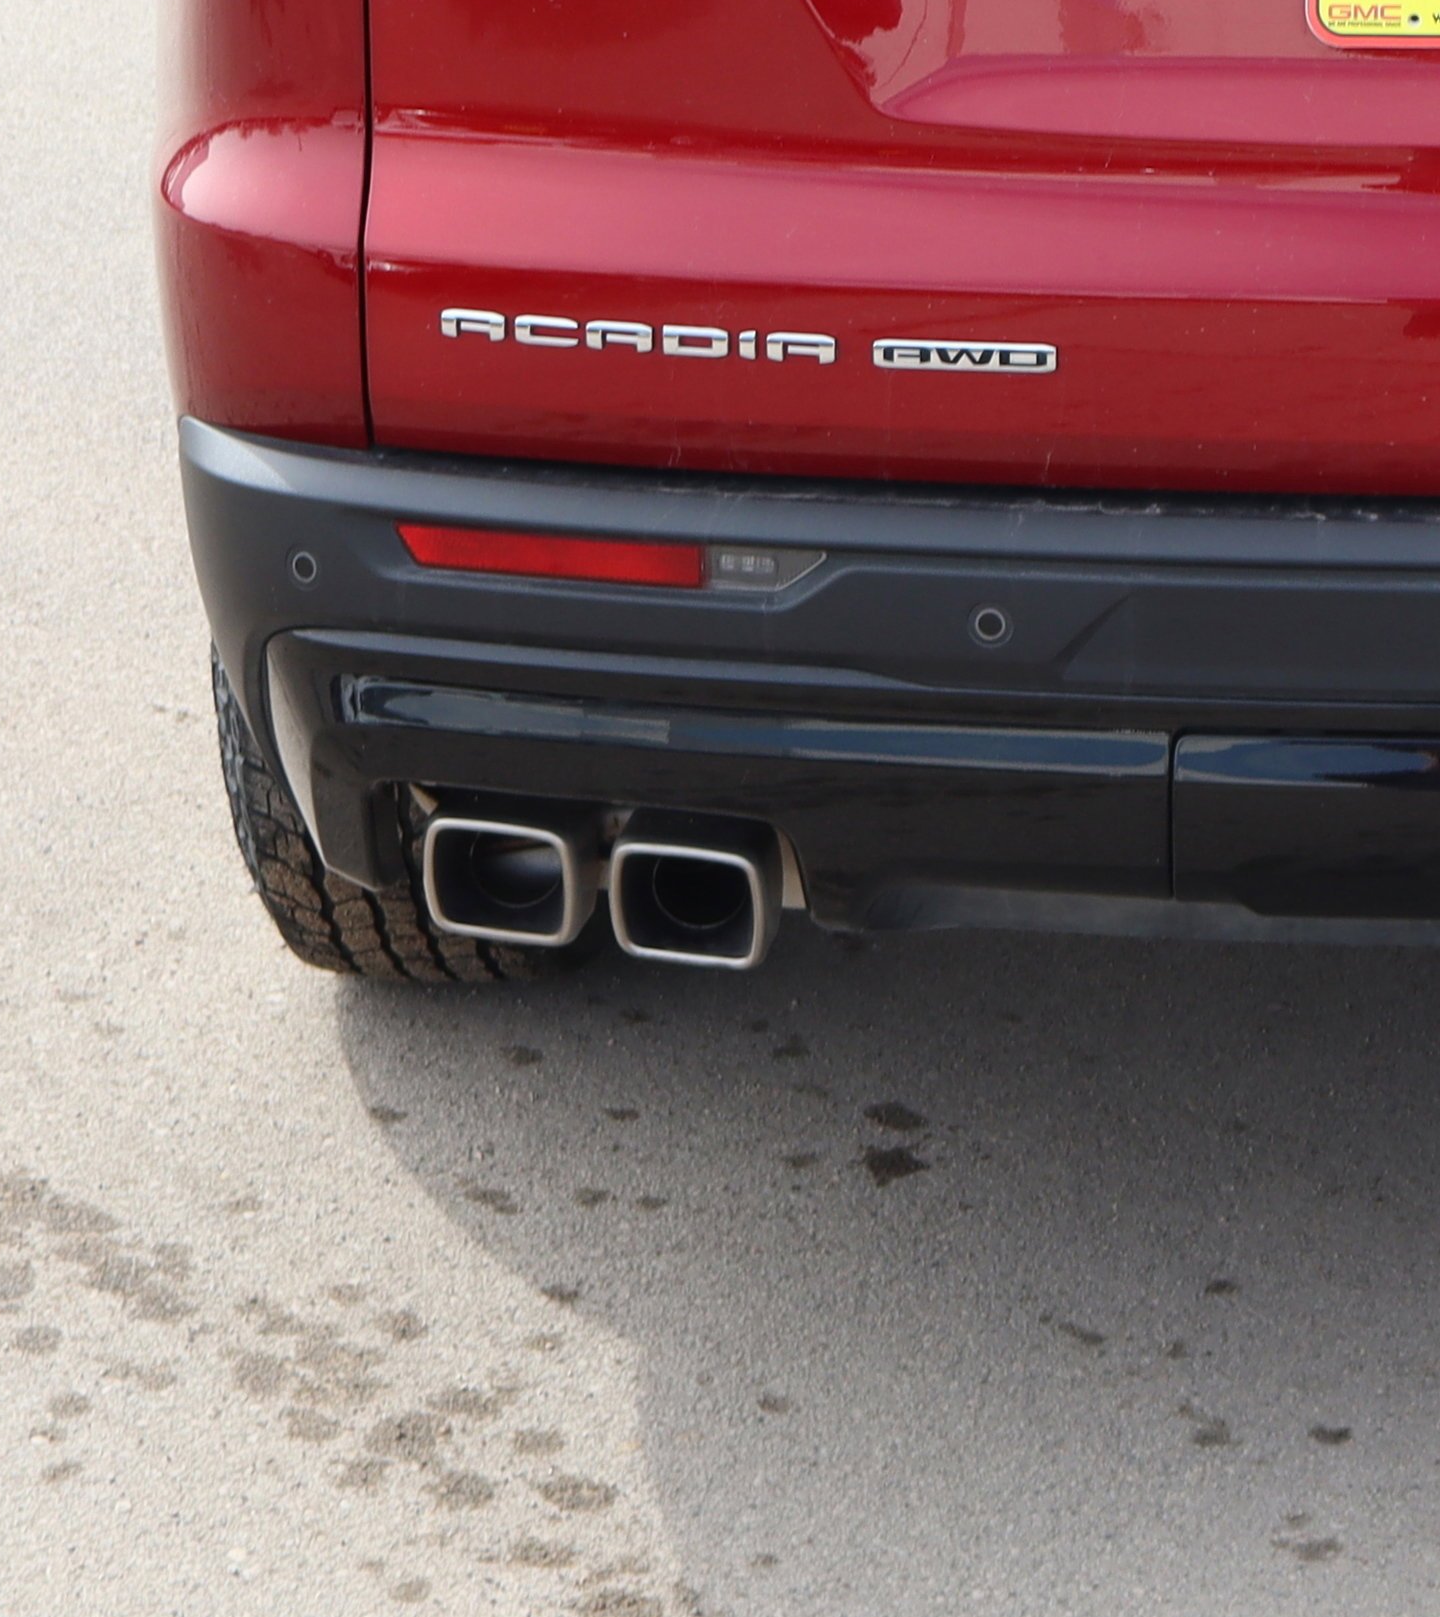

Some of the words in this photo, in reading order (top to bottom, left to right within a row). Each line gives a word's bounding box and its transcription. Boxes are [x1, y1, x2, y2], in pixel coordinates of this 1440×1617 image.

[1327, 3, 1402, 21] GMC
[440, 307, 837, 365] ACADIA
[880, 343, 1050, 369] AWD
